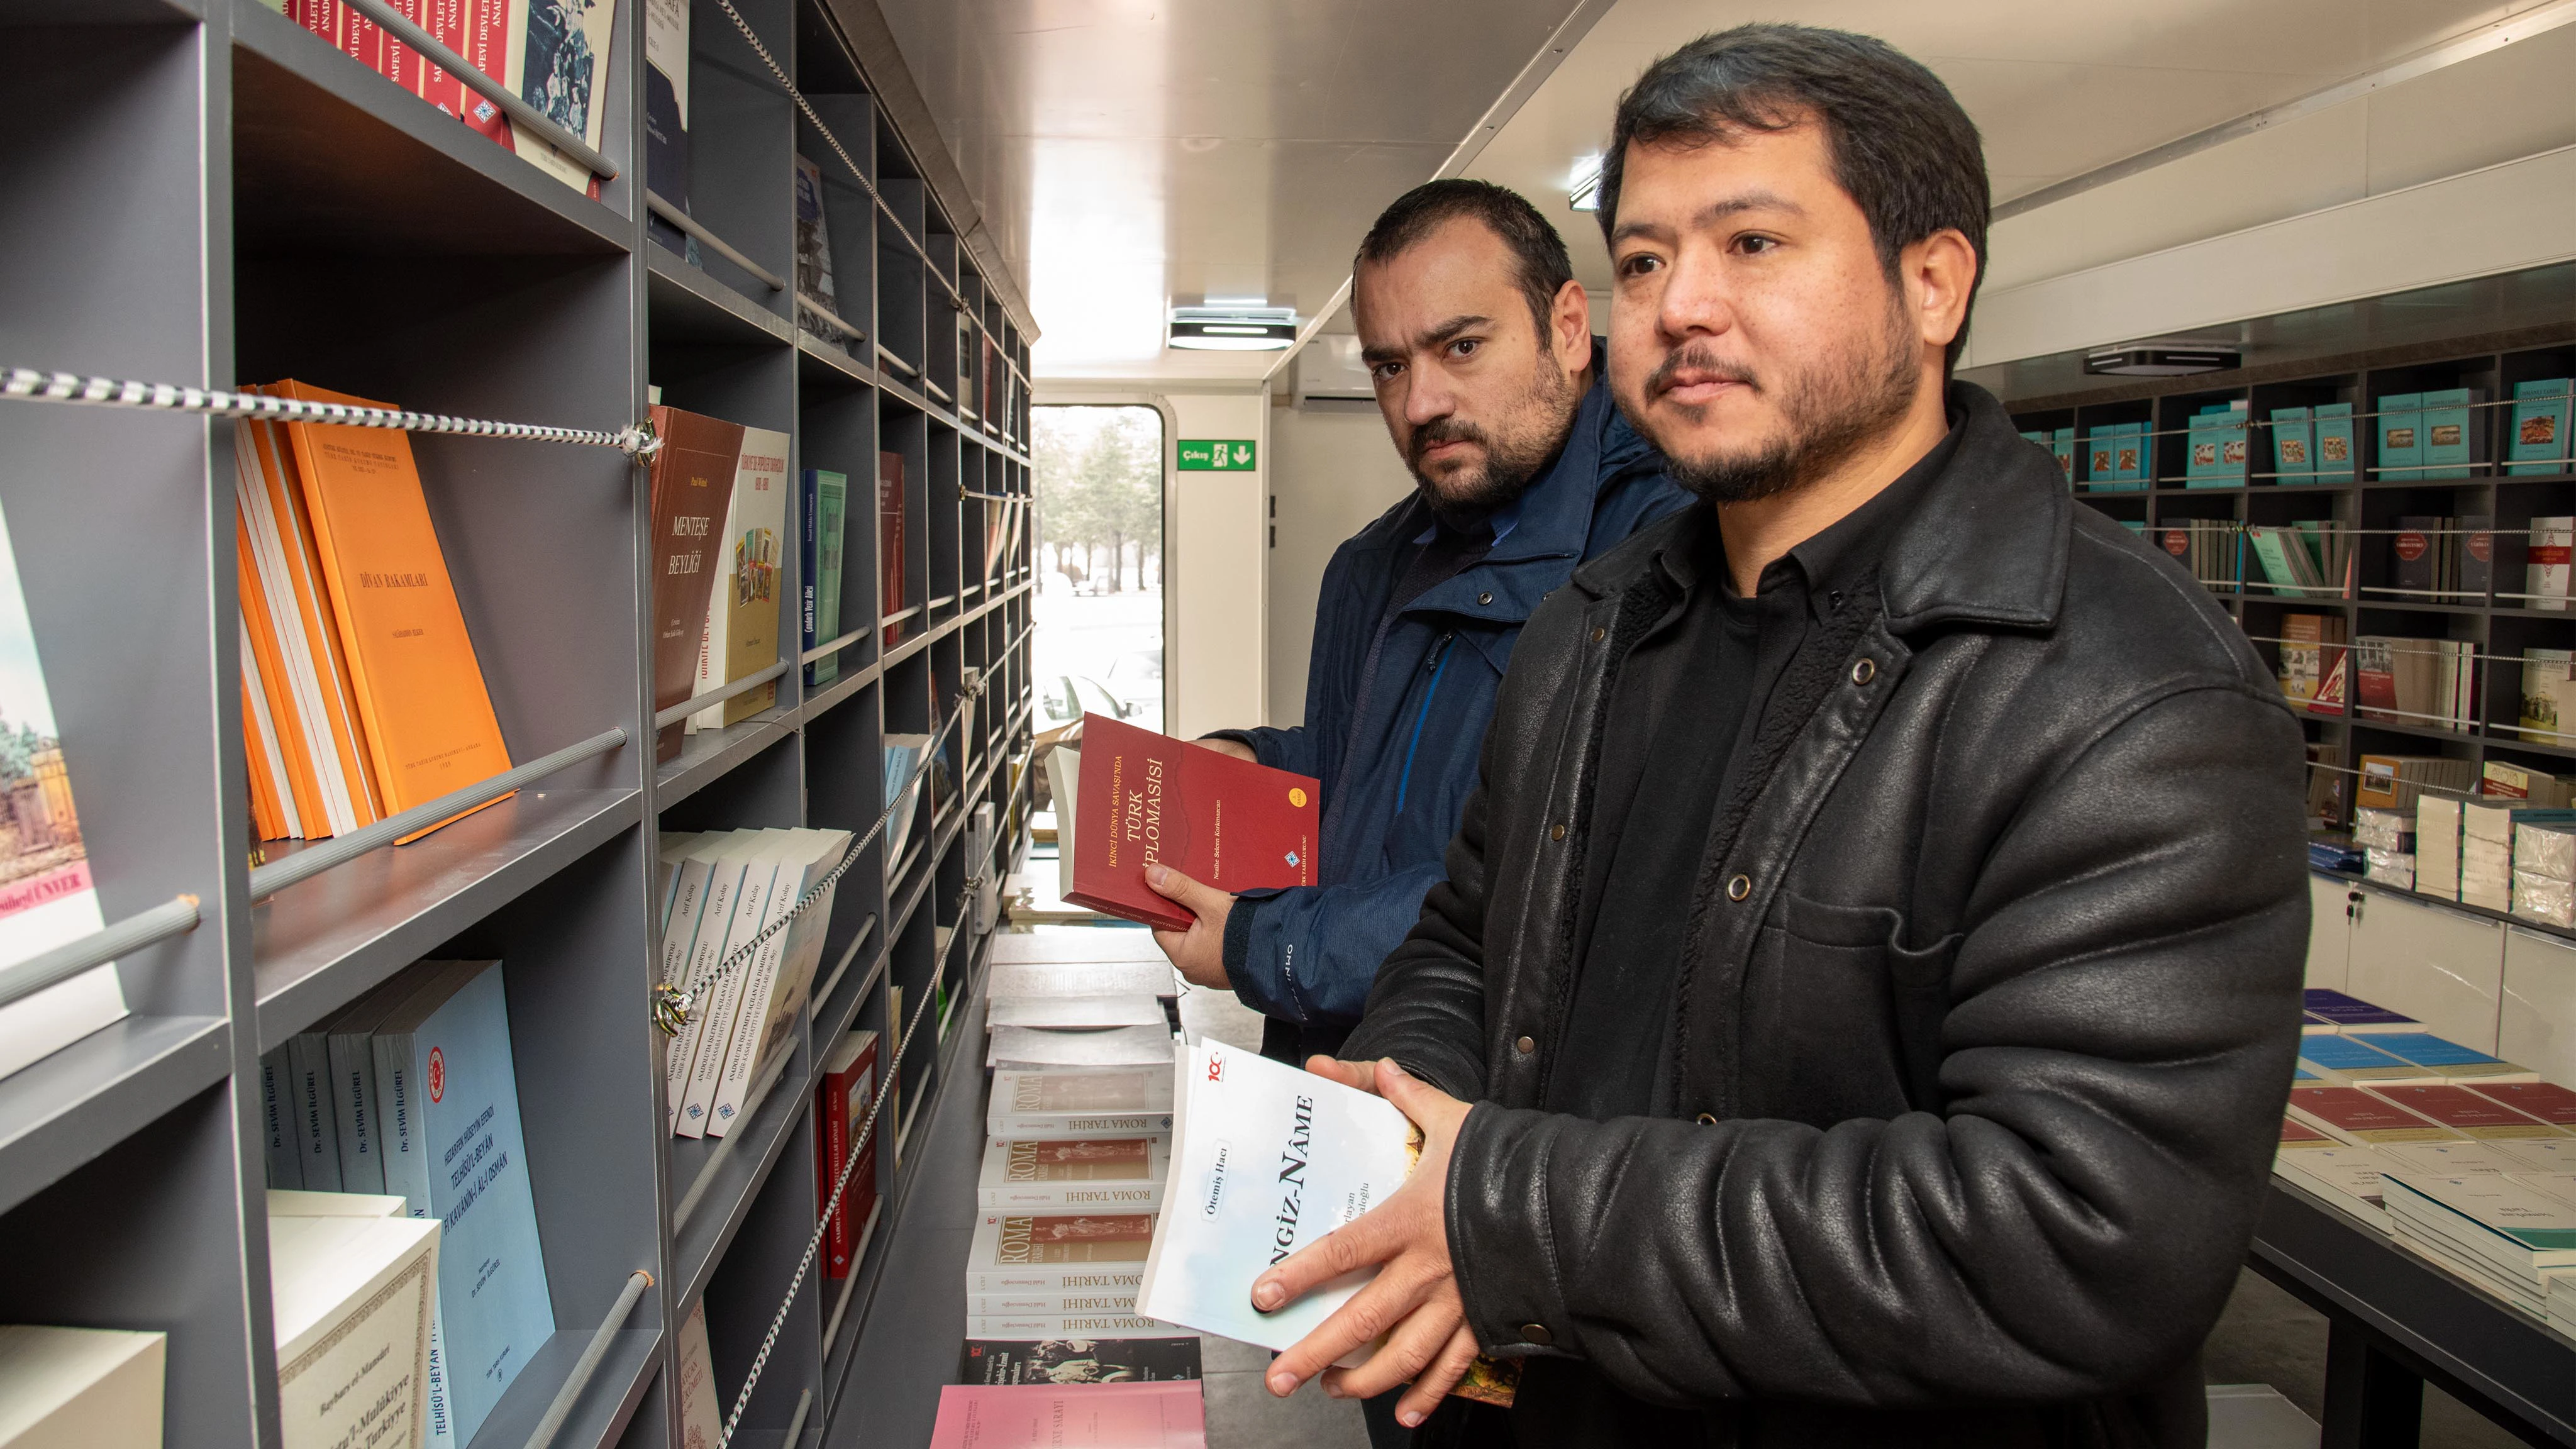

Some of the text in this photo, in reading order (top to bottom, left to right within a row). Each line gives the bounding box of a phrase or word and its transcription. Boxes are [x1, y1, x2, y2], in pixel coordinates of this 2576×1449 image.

[477, 43, 487, 74] AFEVÎ
[1182, 450, 1209, 461] Çıkış
[672, 516, 710, 541] MENTEŞE
[360, 571, 428, 588] DİVAN RAKAMLARI
[668, 550, 702, 575] BEYLİĞİ
[805, 598, 814, 611] Vezir
[804, 611, 814, 633] Çandarlı
[1109, 755, 1122, 868] İKİNCİ DÜNYA SAVAŞI'NDA
[1125, 789, 1143, 841] TÜRK
[1142, 758, 1163, 868] PLOMASİSİ
[682, 883, 696, 918] Arif Kolay
[714, 882, 730, 917] Arif Kolay
[746, 884, 761, 918] Arif Kolay
[777, 882, 792, 917] Arif Kolay
[696, 941, 708, 978] DEMİRYOLU
[705, 1039, 721, 1080] İZMİR-KASABA
[723, 1011, 729, 1020] VE
[726, 975, 739, 1011] UZANTILARI
[729, 1044, 743, 1082] ANADOLU'DA
[739, 1011, 751, 1044] İŞLETMEYE
[748, 990, 757, 1011] AÇILAN
[757, 941, 771, 979] DEMİRYOLU
[736, 1038, 752, 1080] İZMİR-KASABA
[750, 1021, 758, 1038] HATTI
[754, 1011, 760, 1020] VE
[757, 974, 771, 1011] UZANTILARI
[698, 1045, 711, 1082] ANADOLU'DA
[708, 1011, 719, 1044] İŞLETMEYE
[717, 991, 726, 1011] AÇILAN
[675, 1038, 691, 1080] İZMİR-KASABA
[394, 1069, 409, 1153] Dr. SEVİM İLGÜREL
[1015, 1076, 1043, 1112] ROMA
[309, 1110, 321, 1138] SEVİM
[352, 1070, 367, 1153] Dr. SEVİM İLGÜREL
[1068, 1119, 1111, 1130] TARİHİ
[1112, 1118, 1148, 1128] ROMA
[443, 1102, 495, 1167] HEZARFEN HÜSEYİN EFENDİ
[1008, 1141, 1038, 1182] ROMA
[1065, 1191, 1110, 1204] TARİHİ
[1112, 1190, 1152, 1201] ROMA
[1204, 1147, 1227, 1215] Ötemiş Hacı
[1269, 1095, 1313, 1267] NGİZ-NÂME
[1345, 1192, 1355, 1225] rlayan
[1358, 1182, 1369, 1218] aloğlu
[1000, 1216, 1033, 1264] ROMA
[1032, 1243, 1045, 1263] TARİHİ
[1062, 1275, 1111, 1289] TARİHİ
[1113, 1274, 1144, 1286] OMA
[1062, 1297, 1111, 1311] TARİHİ
[1113, 1297, 1137, 1309] MA
[1062, 1318, 1111, 1332] TARİHİ
[1114, 1317, 1155, 1328] ROMA
[319, 1384, 350, 1418] Baybars
[1053, 1401, 1063, 1428] SARAYI
